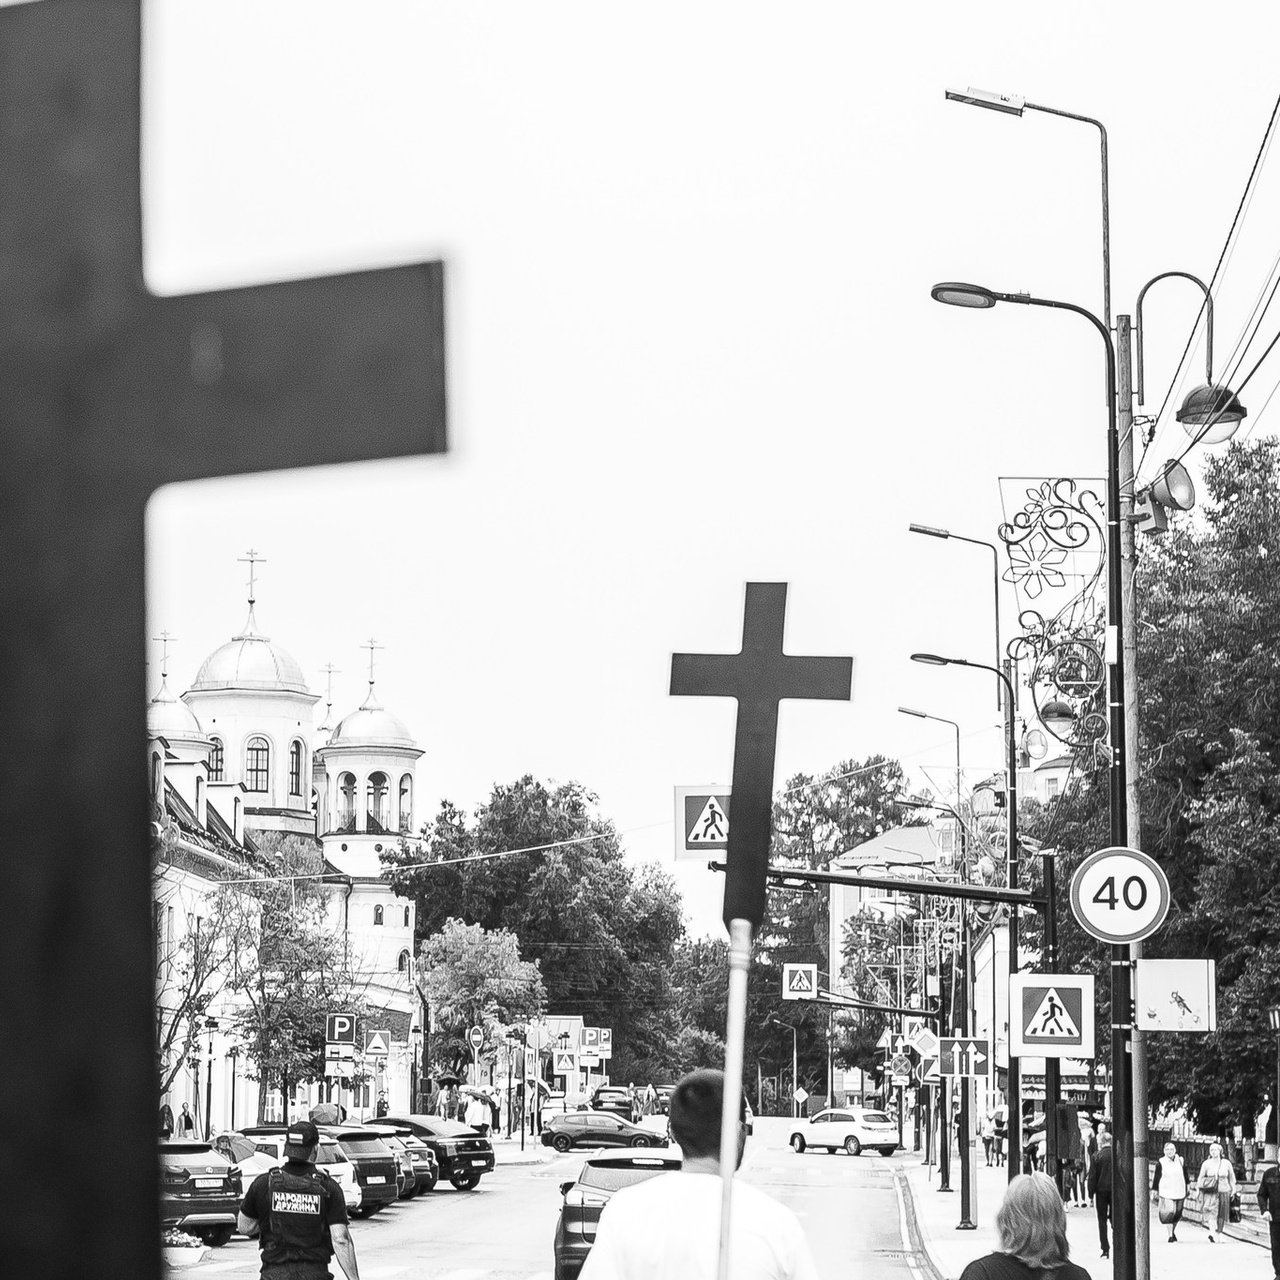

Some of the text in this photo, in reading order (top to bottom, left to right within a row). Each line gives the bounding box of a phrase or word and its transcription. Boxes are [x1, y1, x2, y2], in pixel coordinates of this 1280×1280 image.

[1092, 875, 1147, 911] 40
[334, 1017, 350, 1039] P
[586, 1030, 597, 1045] P
[601, 1030, 609, 1042] P
[275, 1192, 318, 1204] НАРОДНАЯ
[275, 1201, 316, 1212] ДРУЖИНА
